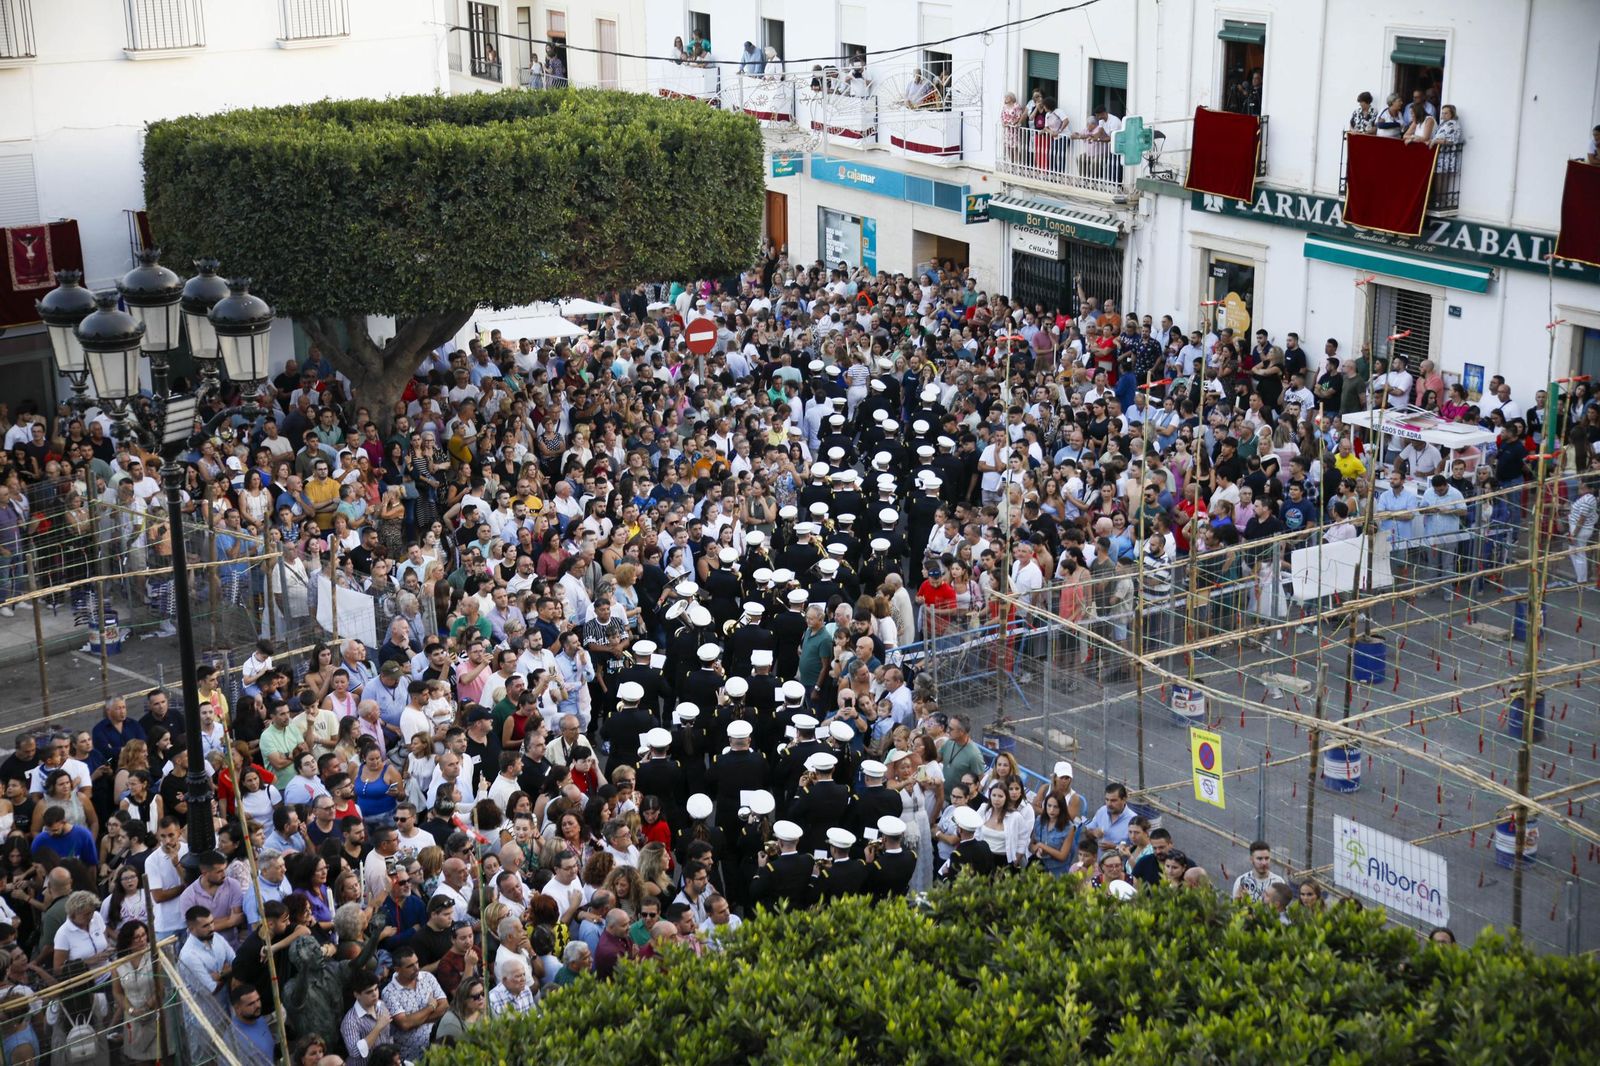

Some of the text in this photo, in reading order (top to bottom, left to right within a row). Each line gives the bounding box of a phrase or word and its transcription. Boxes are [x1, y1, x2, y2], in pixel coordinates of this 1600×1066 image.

[847, 169, 876, 184] cajamar
[1026, 213, 1076, 236] Bar Tangay
[1028, 244, 1059, 257] CHURROS
[1397, 428, 1406, 437] DE
[1368, 857, 1441, 906] Alborán
